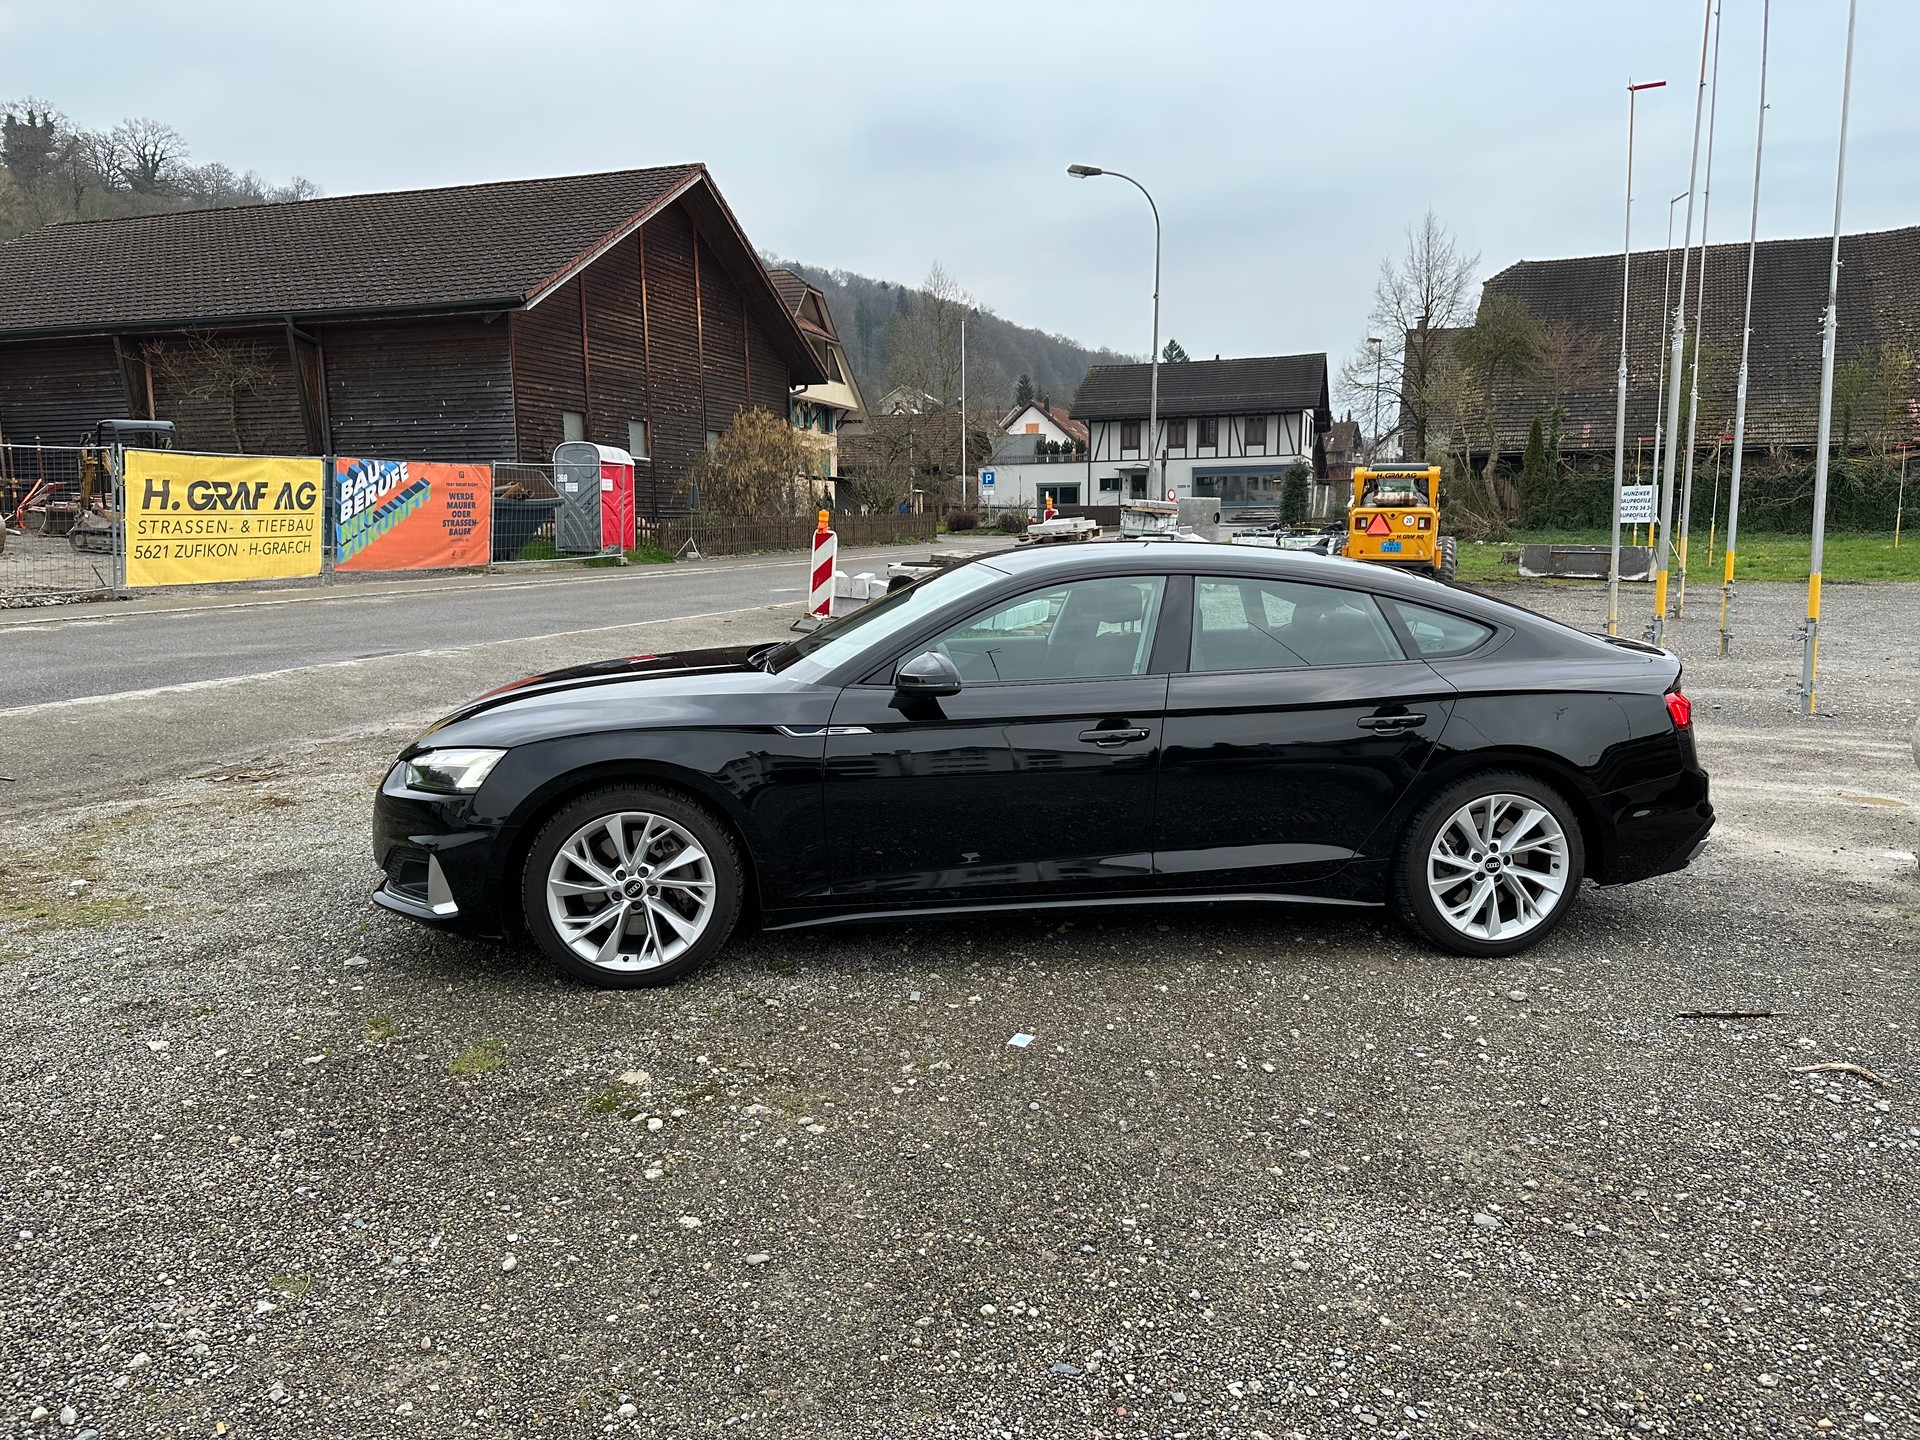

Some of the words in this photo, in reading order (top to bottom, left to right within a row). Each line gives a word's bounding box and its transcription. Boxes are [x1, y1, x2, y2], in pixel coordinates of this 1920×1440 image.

[985, 473, 992, 484] P
[141, 478, 181, 511] H.
[187, 480, 269, 511] GRAF
[273, 481, 317, 511] AG
[340, 462, 410, 524] BERUFE
[448, 492, 474, 501] WERDE
[446, 501, 476, 509] MAURER
[451, 510, 471, 518] ODER
[138, 519, 235, 535] STRASSEN-
[240, 519, 250, 533] &
[257, 518, 314, 533] TIEFBAU
[341, 504, 377, 544] MIT
[341, 484, 432, 565] ZUKUNFT!
[442, 519, 479, 528] STRASSEN-
[448, 528, 472, 536] BAUER
[134, 544, 169, 559] 5621
[174, 542, 239, 559] ZUFIKON
[249, 540, 311, 556] H-GRAF.CH
